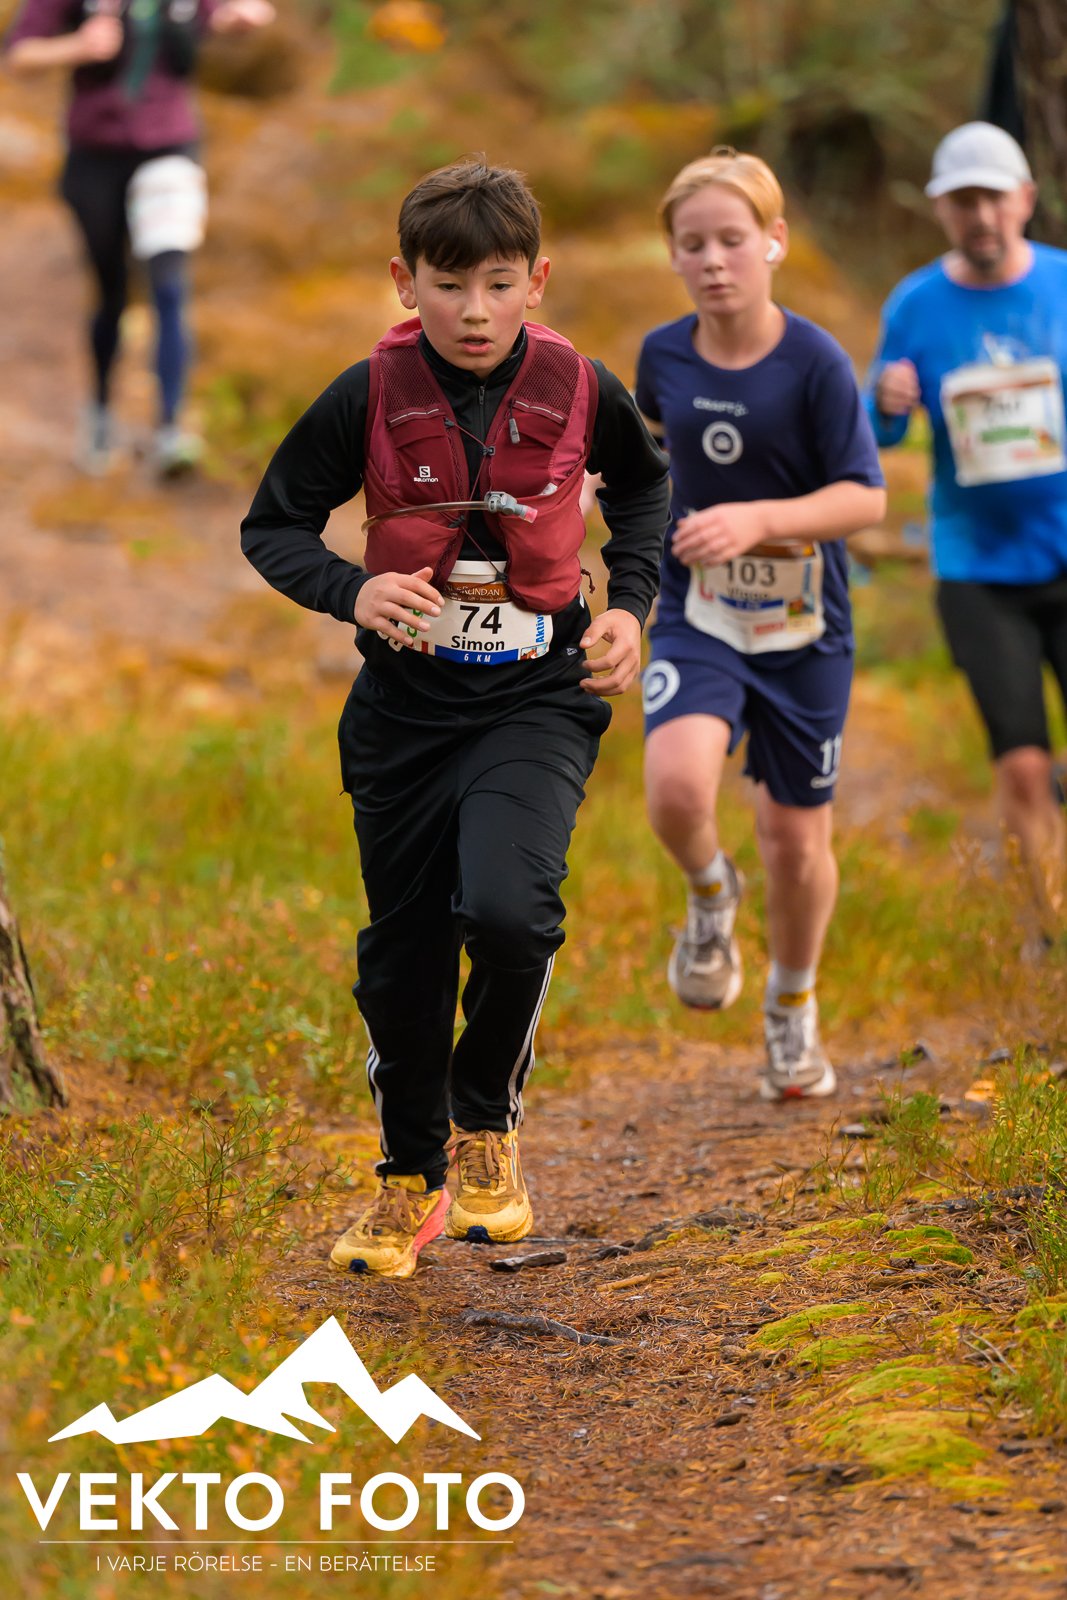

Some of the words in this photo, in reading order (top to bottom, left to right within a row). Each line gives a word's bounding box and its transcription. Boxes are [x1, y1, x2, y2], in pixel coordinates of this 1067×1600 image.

[726, 561, 776, 587] 103
[460, 605, 502, 634] 74
[451, 635, 505, 651] Simon
[464, 653, 470, 662] 6
[477, 654, 492, 663] KM
